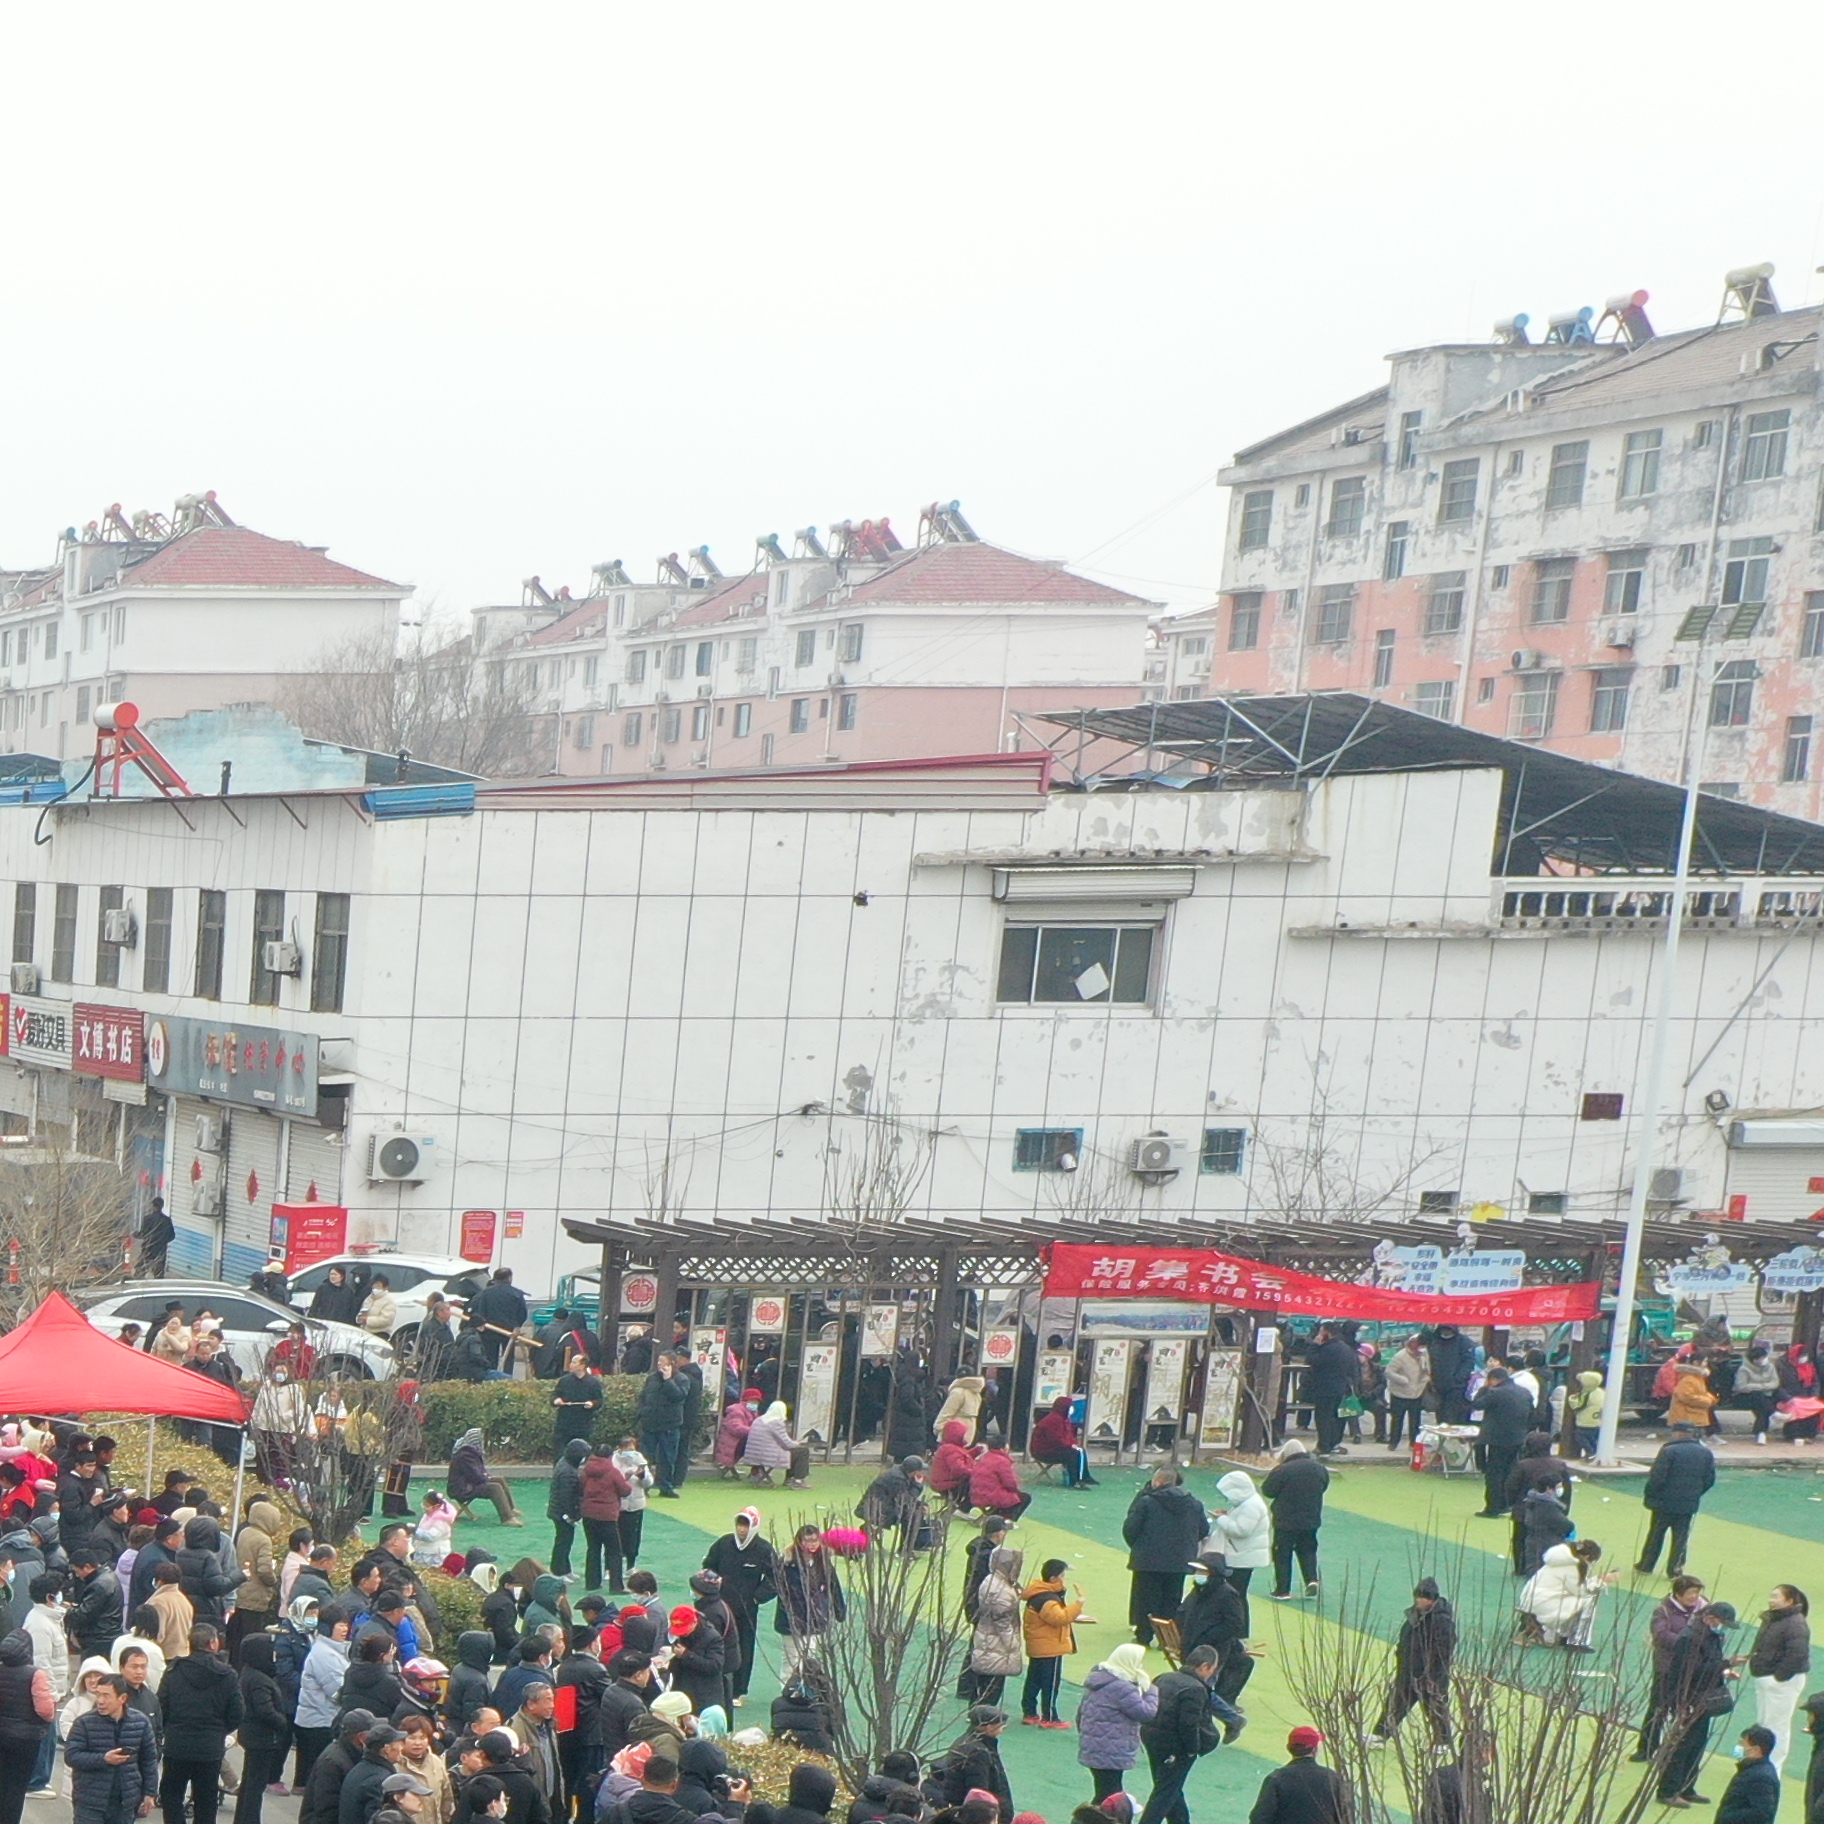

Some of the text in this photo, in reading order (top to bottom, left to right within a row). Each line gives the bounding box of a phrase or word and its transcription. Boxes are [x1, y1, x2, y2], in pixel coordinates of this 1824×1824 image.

[26, 1012, 66, 1053] 爱好文具
[79, 1020, 133, 1065] 文博书店
[1091, 1257, 1287, 1290] 胡集书会
